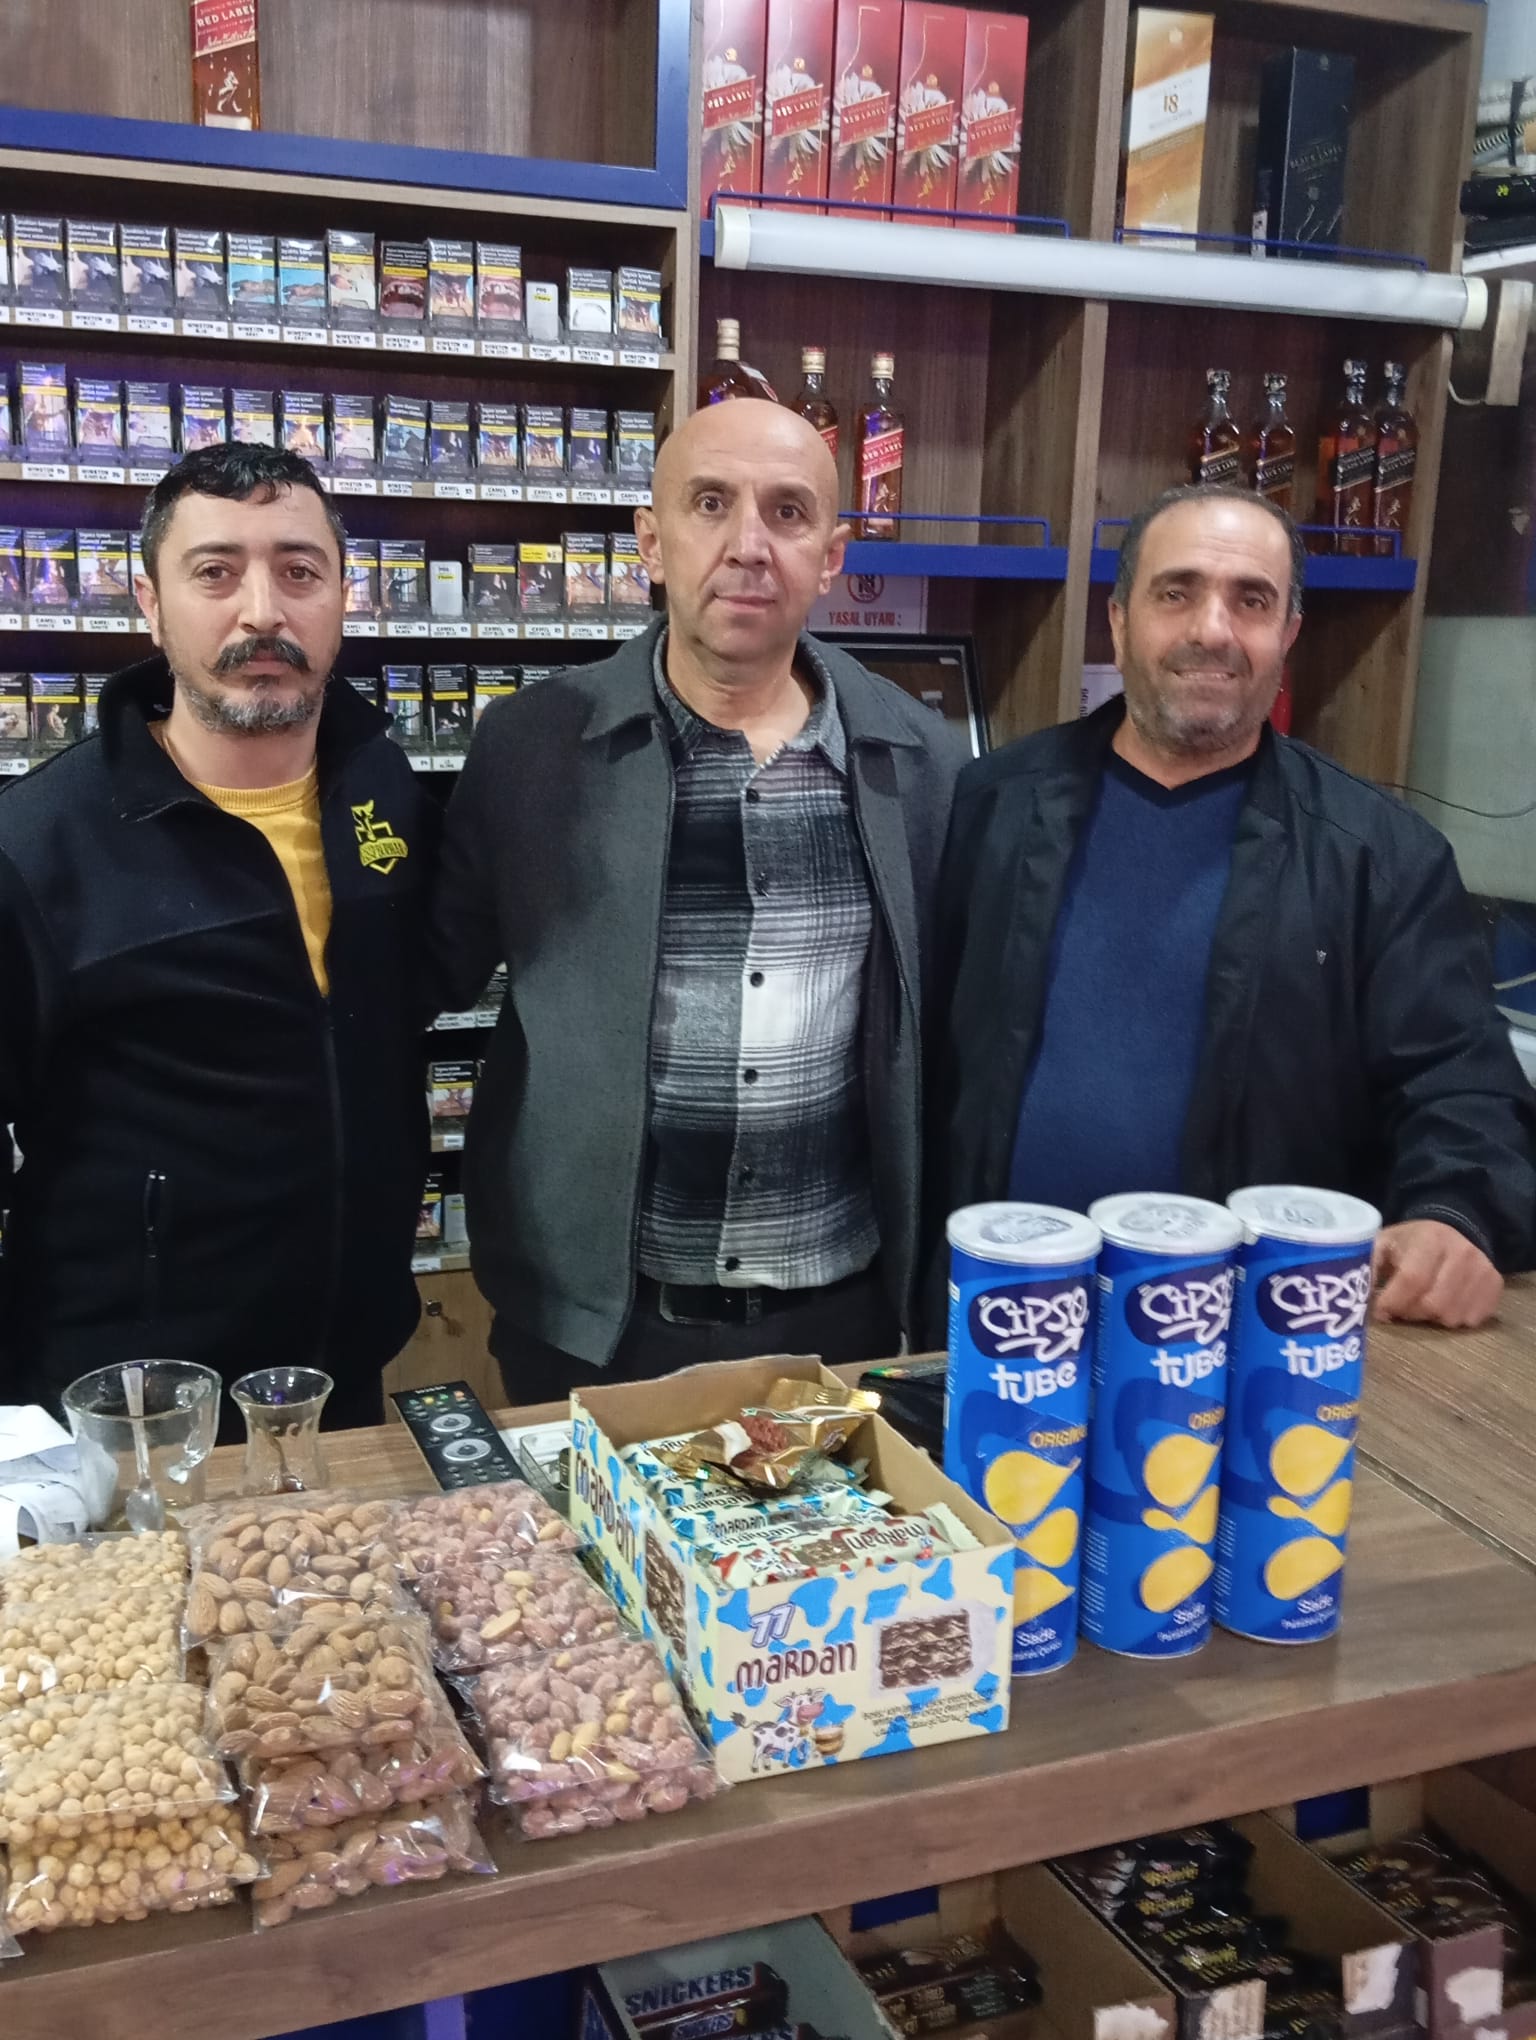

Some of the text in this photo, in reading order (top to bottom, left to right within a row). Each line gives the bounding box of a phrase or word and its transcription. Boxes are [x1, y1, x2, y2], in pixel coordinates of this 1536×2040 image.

[196, 5, 255, 27] RED LABEL
[1016, 1627, 1056, 1647] Sade
[624, 1965, 752, 2017] SNICKERS
